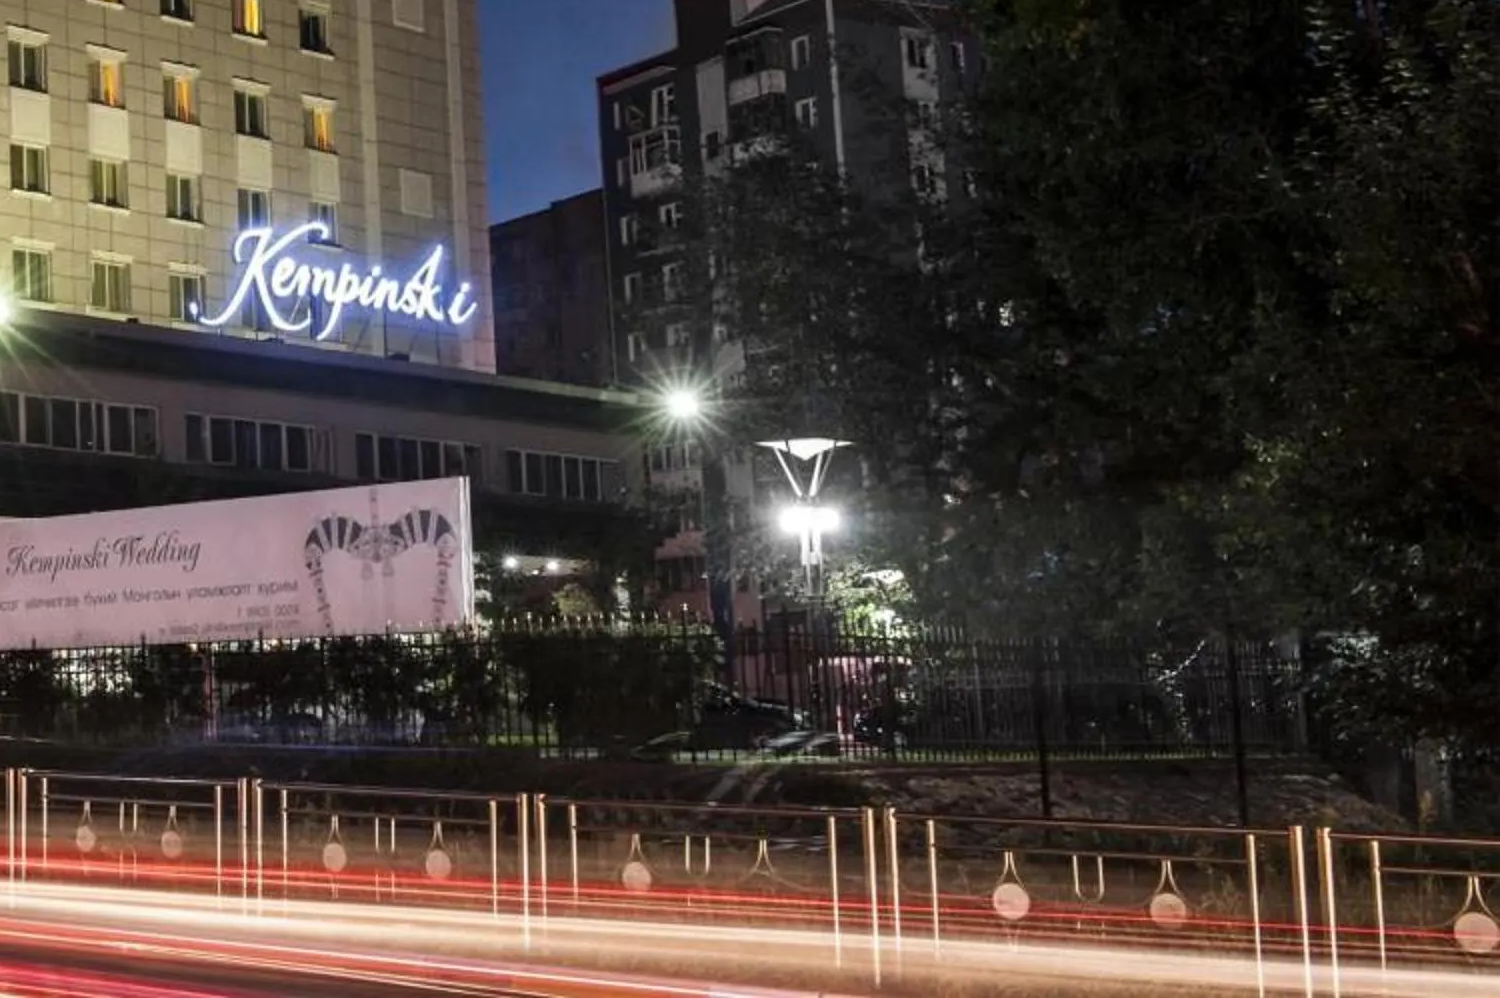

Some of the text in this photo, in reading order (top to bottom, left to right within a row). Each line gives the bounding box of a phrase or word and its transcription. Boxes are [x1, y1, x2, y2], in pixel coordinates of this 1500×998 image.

[189, 222, 477, 341] Kempinski
[6, 529, 201, 583] Kempinski Wedding
